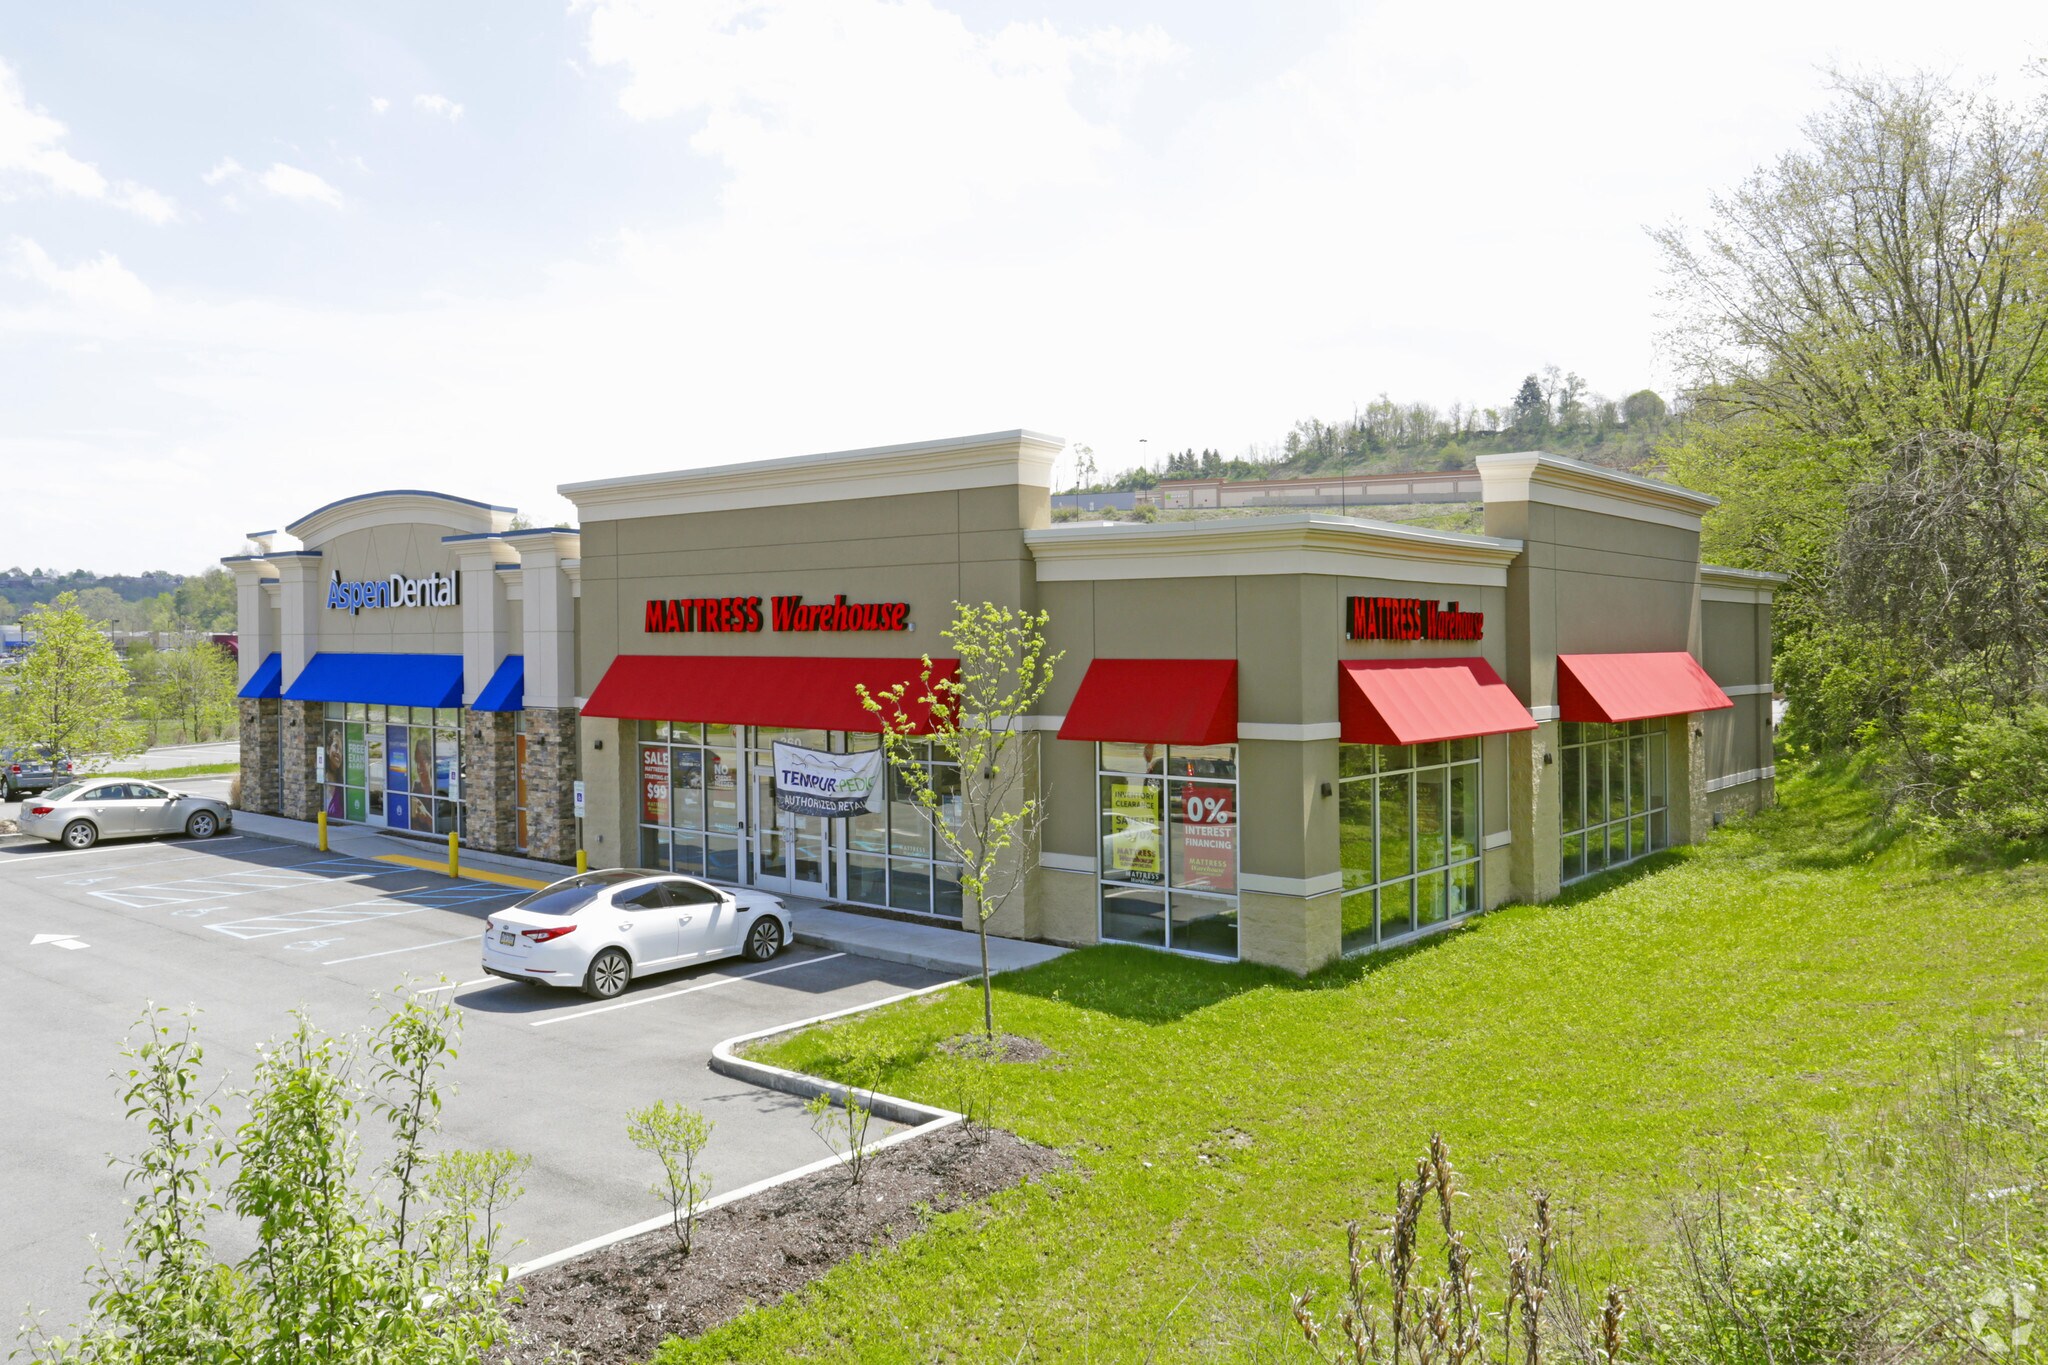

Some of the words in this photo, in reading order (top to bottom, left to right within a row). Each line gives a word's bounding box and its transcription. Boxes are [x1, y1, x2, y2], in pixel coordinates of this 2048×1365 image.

[645, 597, 762, 633] MATTRESS
[771, 595, 909, 632] Warehouse
[1353, 596, 1421, 640] MATTRESS
[1426, 600, 1484, 640] Warehouse
[348, 743, 365, 754] FREE
[644, 751, 669, 765] SALE
[714, 764, 728, 775] NO
[647, 782, 667, 799] $99
[784, 795, 837, 811] AUTHORIZED
[1115, 800, 1154, 810] CLEARANCE
[1187, 796, 1228, 824] 0%
[1185, 825, 1231, 837] INTEREST
[1185, 838, 1232, 850] FINANCING
[1189, 858, 1227, 867] MATTRESS
[1125, 871, 1159, 880] MATTRESS
